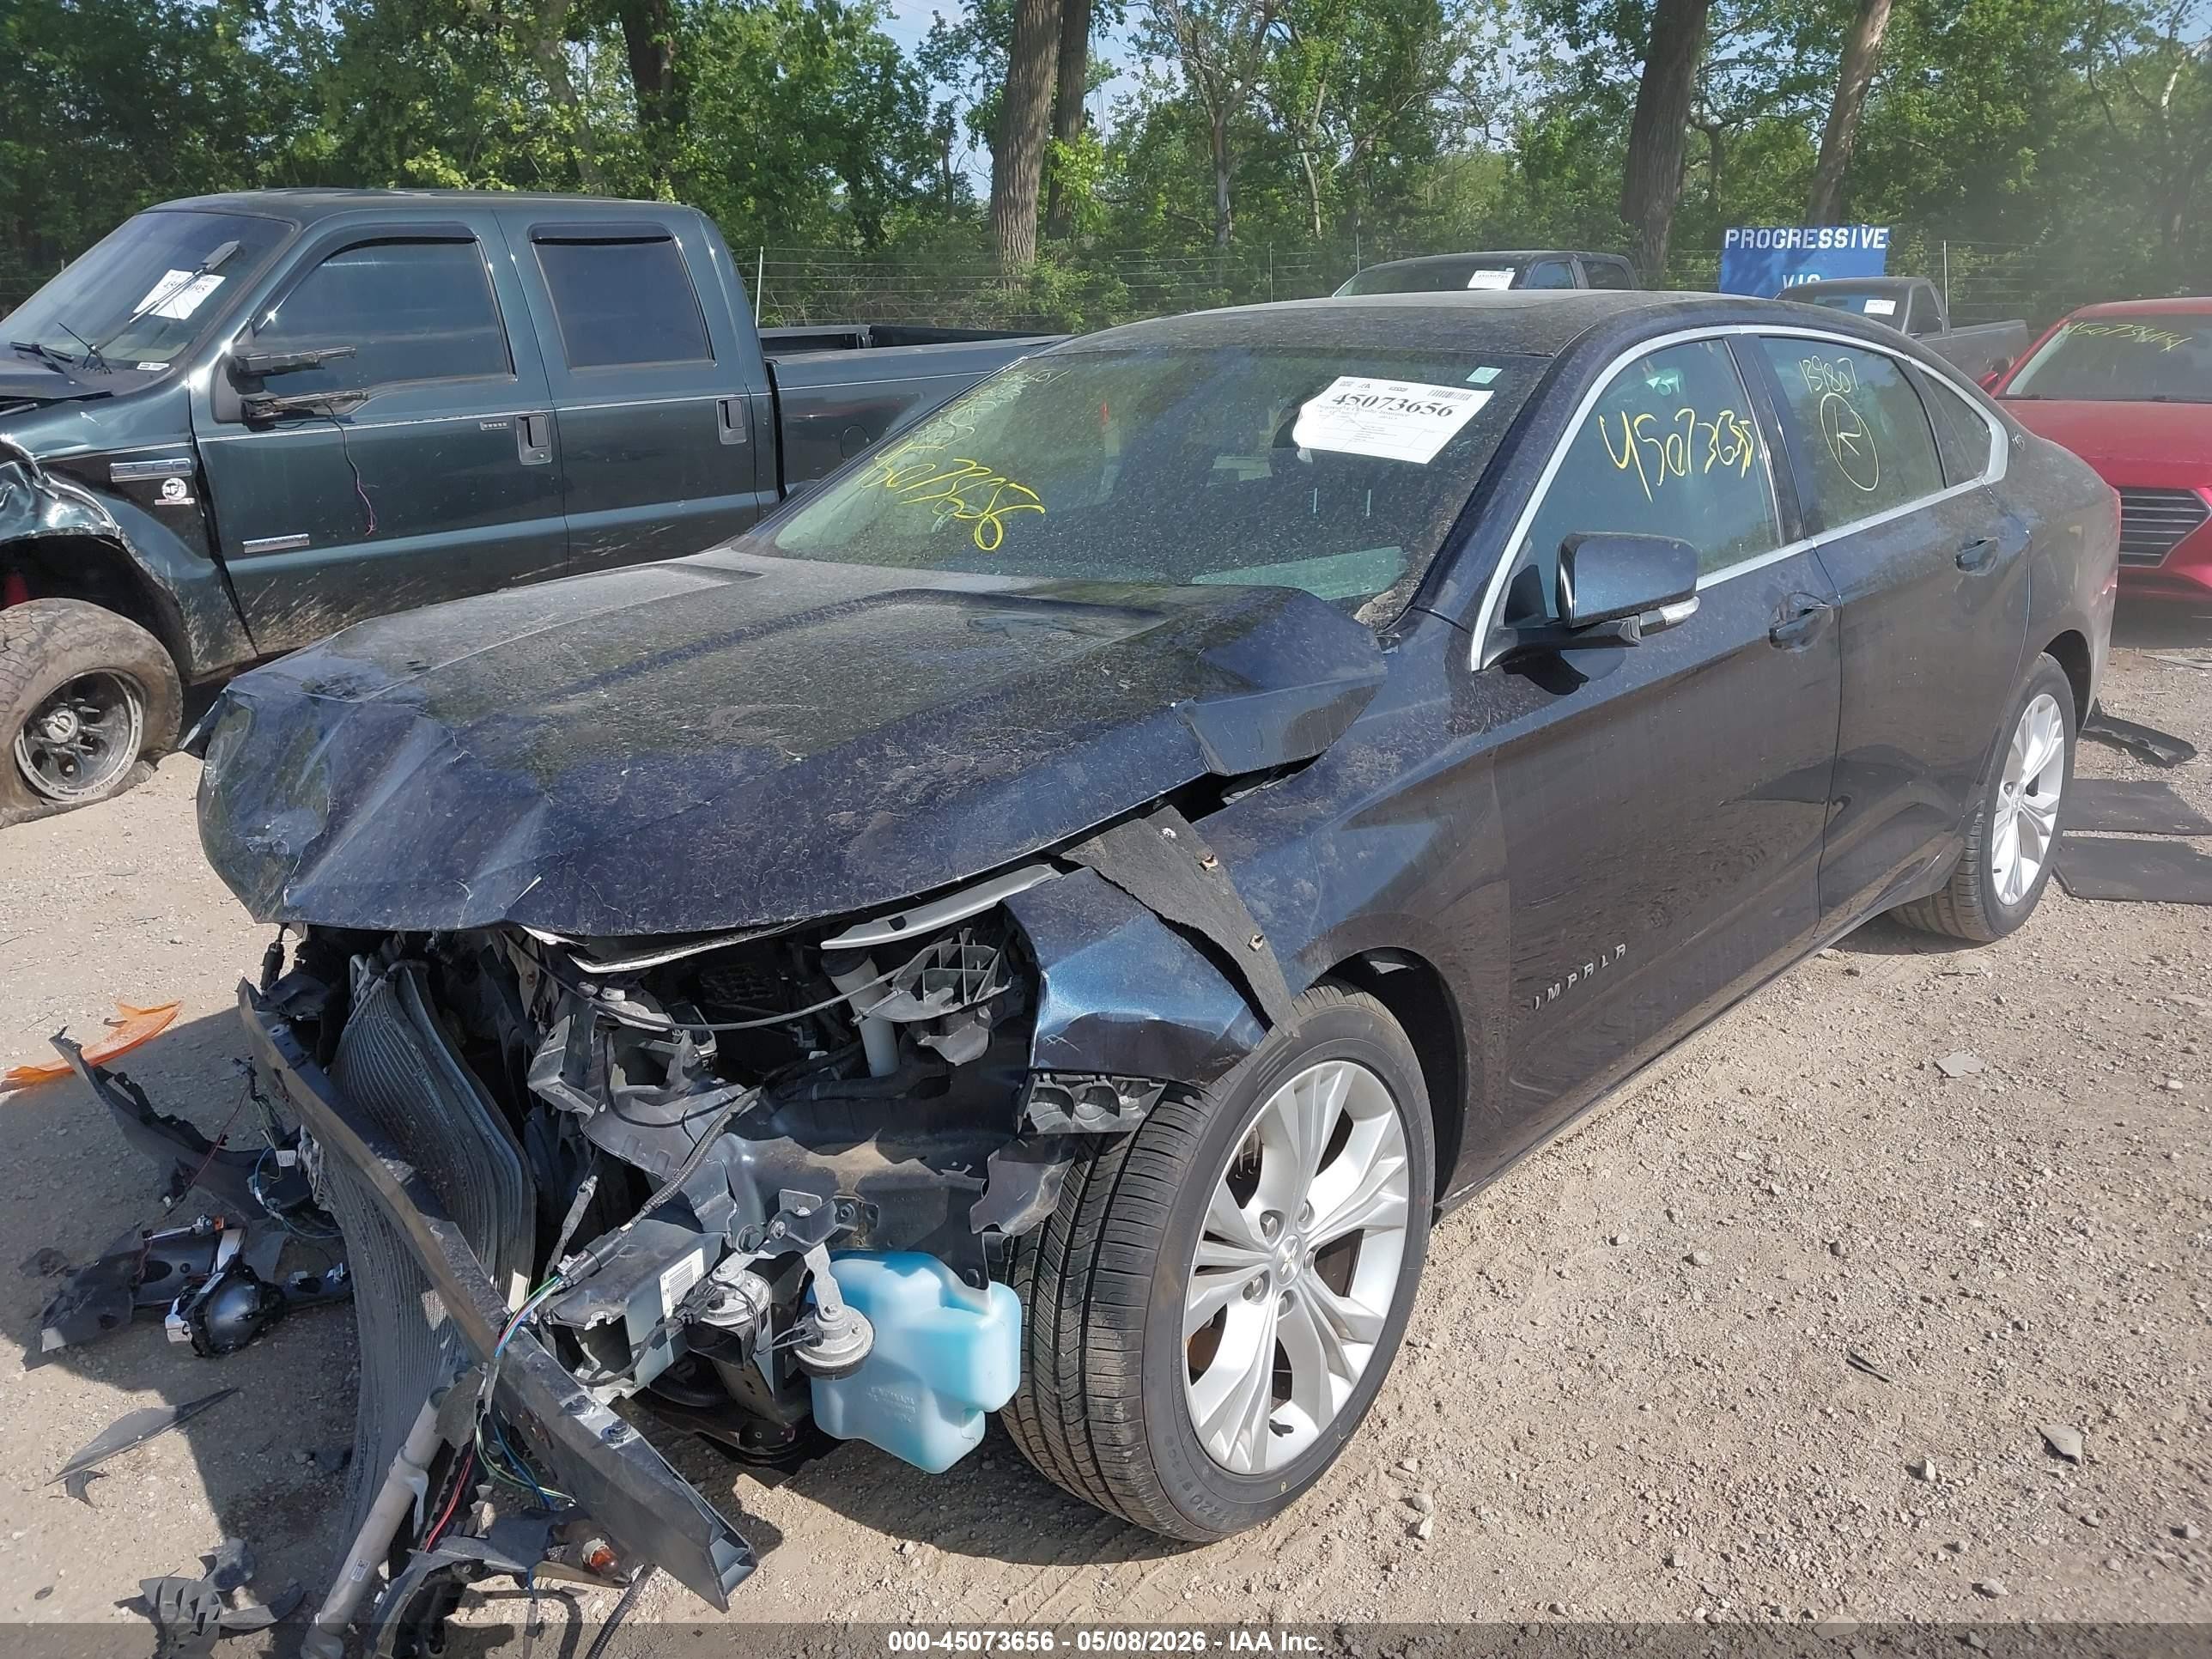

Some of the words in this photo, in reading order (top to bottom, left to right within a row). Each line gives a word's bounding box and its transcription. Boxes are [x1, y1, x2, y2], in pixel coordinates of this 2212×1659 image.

[1724, 228, 1889, 249] PROGRESSIVE
[1332, 392, 1460, 417] 45073656
[1534, 943, 1626, 1011] IMPALA
